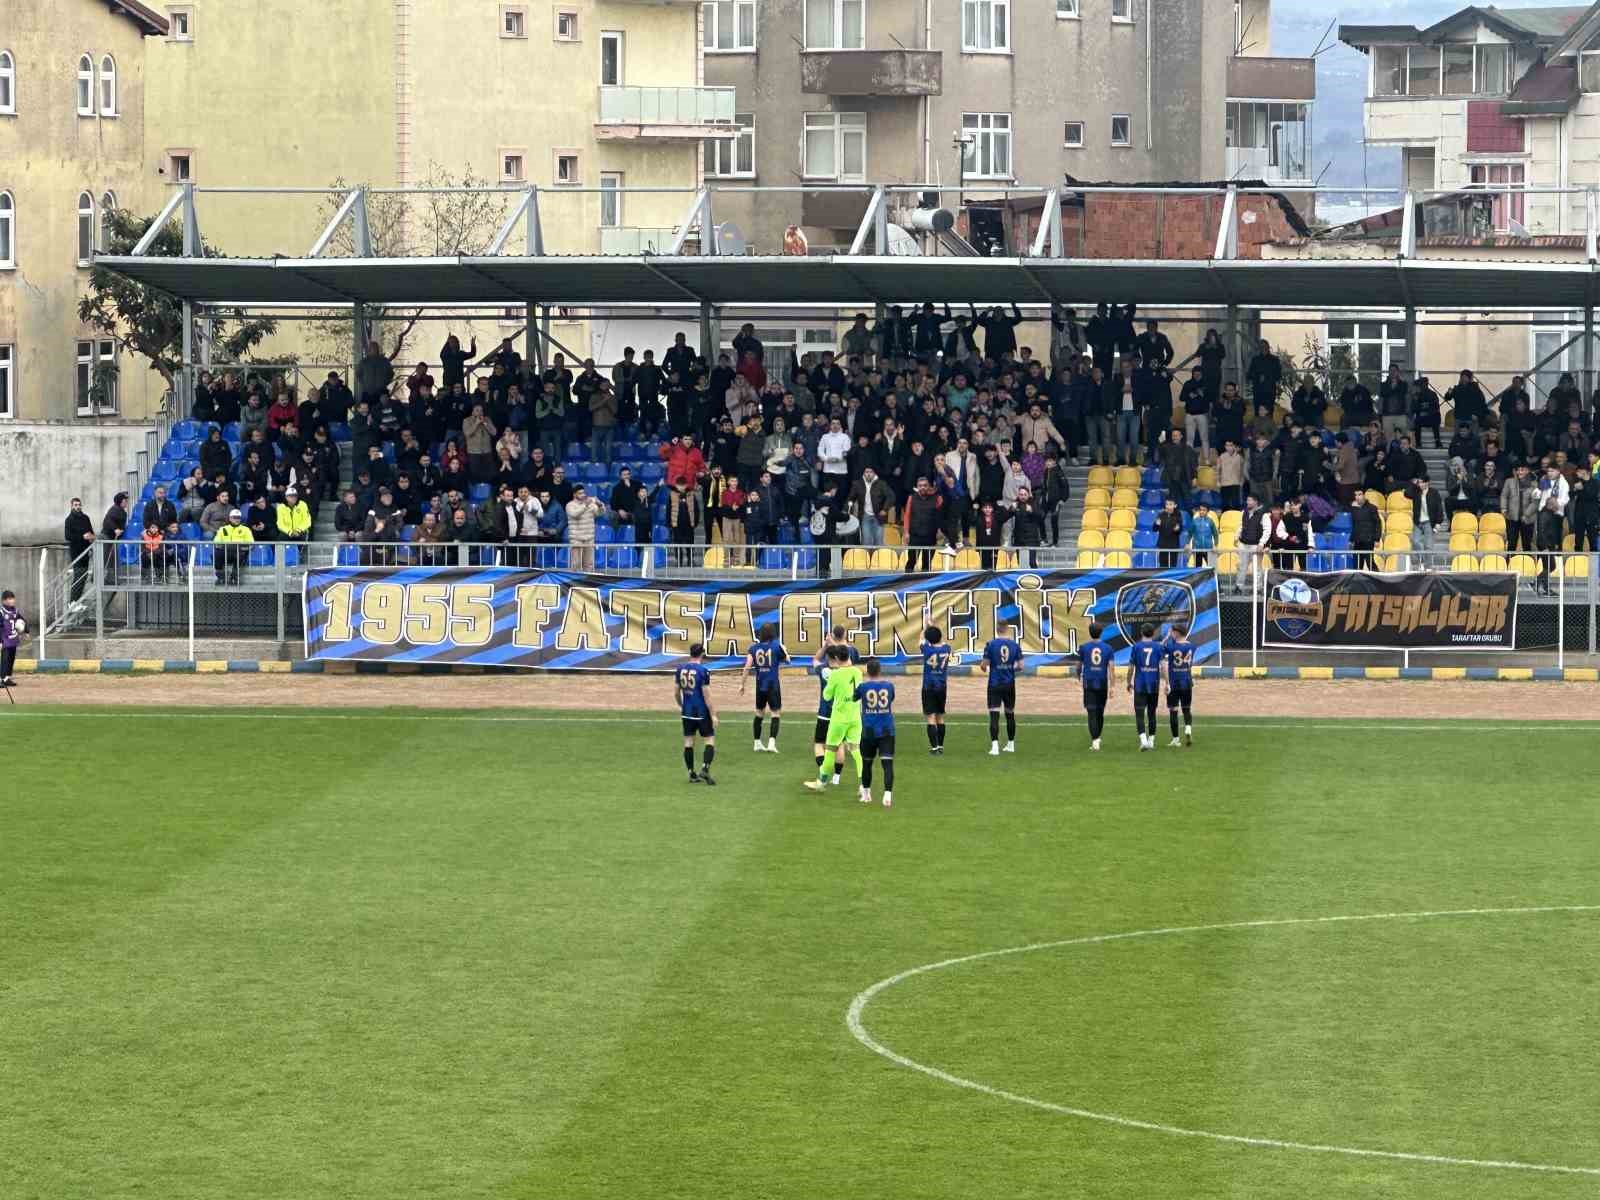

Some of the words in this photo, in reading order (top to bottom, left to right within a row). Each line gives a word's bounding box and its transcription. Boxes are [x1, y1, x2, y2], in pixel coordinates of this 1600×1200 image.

[322, 582, 494, 646] 1955
[512, 583, 760, 657] FATSA
[1325, 592, 1510, 634] FATSALILAR
[755, 648, 773, 667] 61
[926, 653, 949, 670] 47
[1000, 645, 1010, 663] 9
[1090, 647, 1102, 666] 6
[1143, 647, 1153, 666] 7
[1173, 649, 1193, 667] 34
[680, 669, 697, 689] 55
[866, 688, 889, 709] 93
